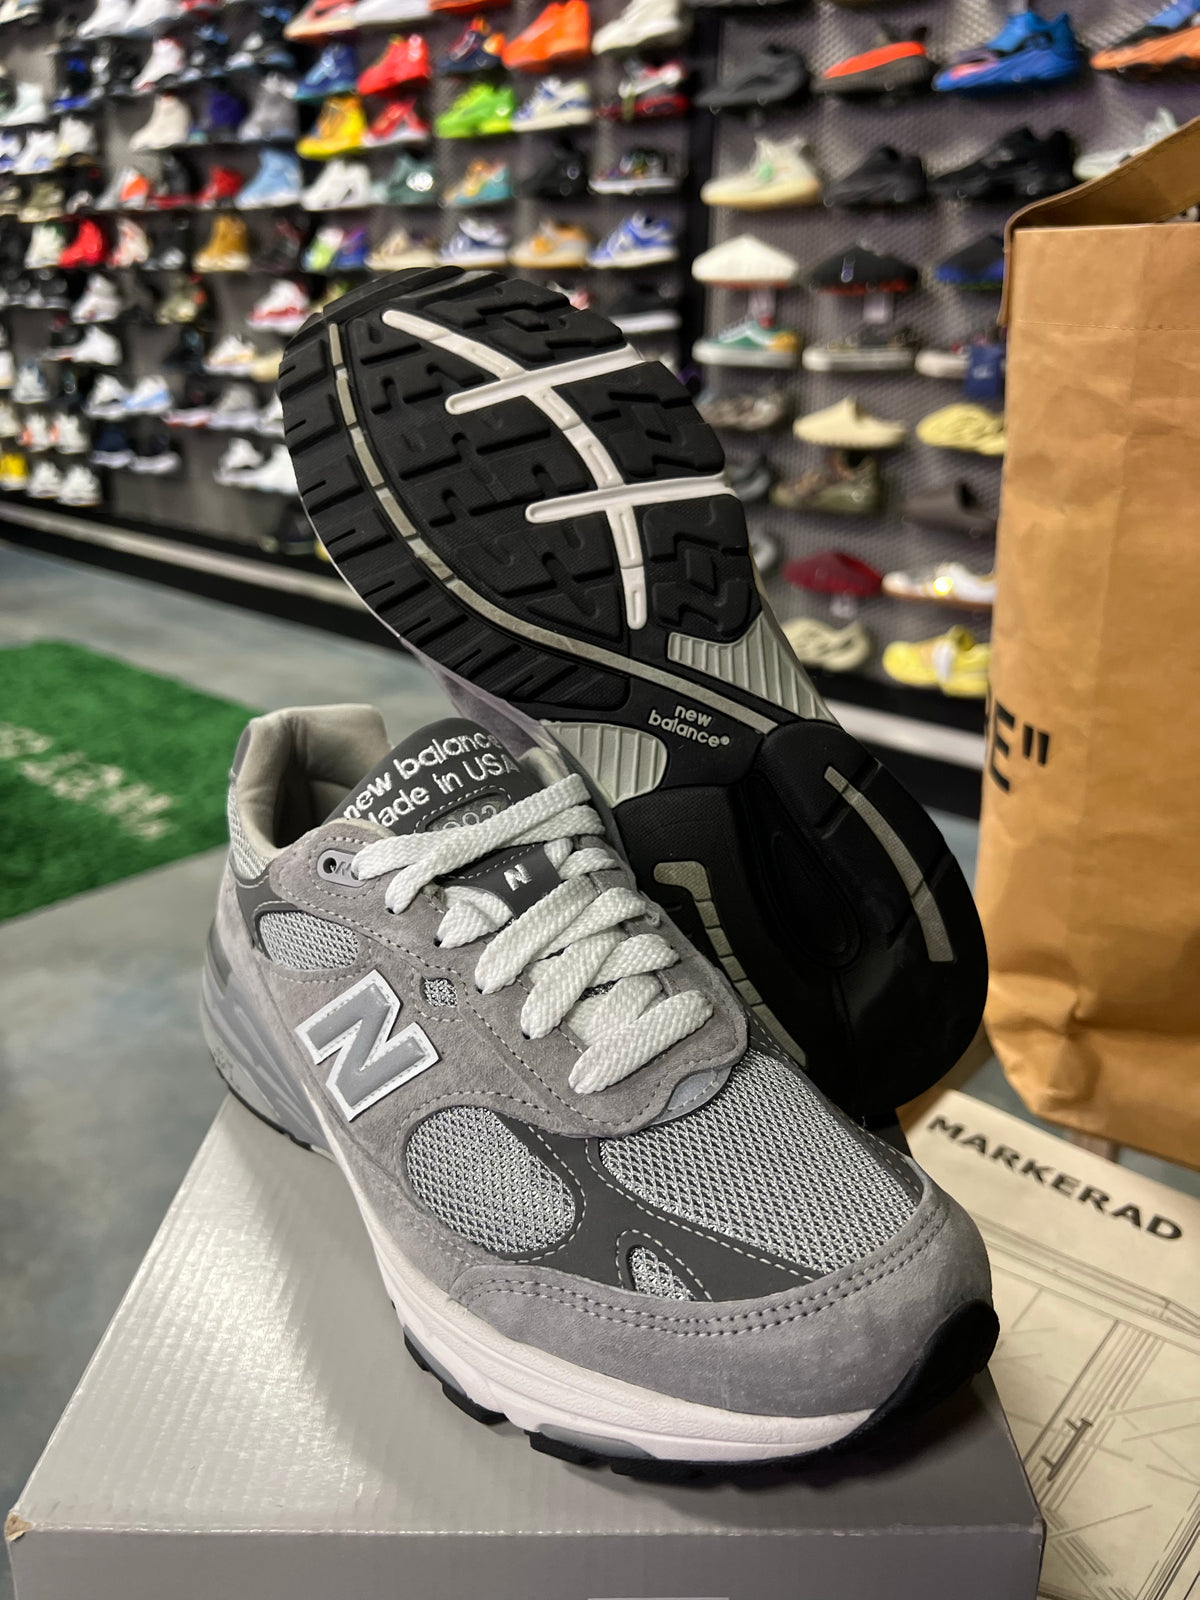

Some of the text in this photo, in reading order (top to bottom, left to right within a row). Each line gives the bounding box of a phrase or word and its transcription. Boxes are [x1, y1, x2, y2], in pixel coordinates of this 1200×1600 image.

[674, 705, 712, 728] new
[343, 772, 393, 819] new
[393, 732, 503, 780] balance
[368, 786, 431, 828] ade
[432, 771, 464, 795] in
[462, 753, 520, 782] USA
[503, 863, 532, 892] N
[295, 969, 440, 1123] N
[927, 1115, 1184, 1240] MARKERAD
